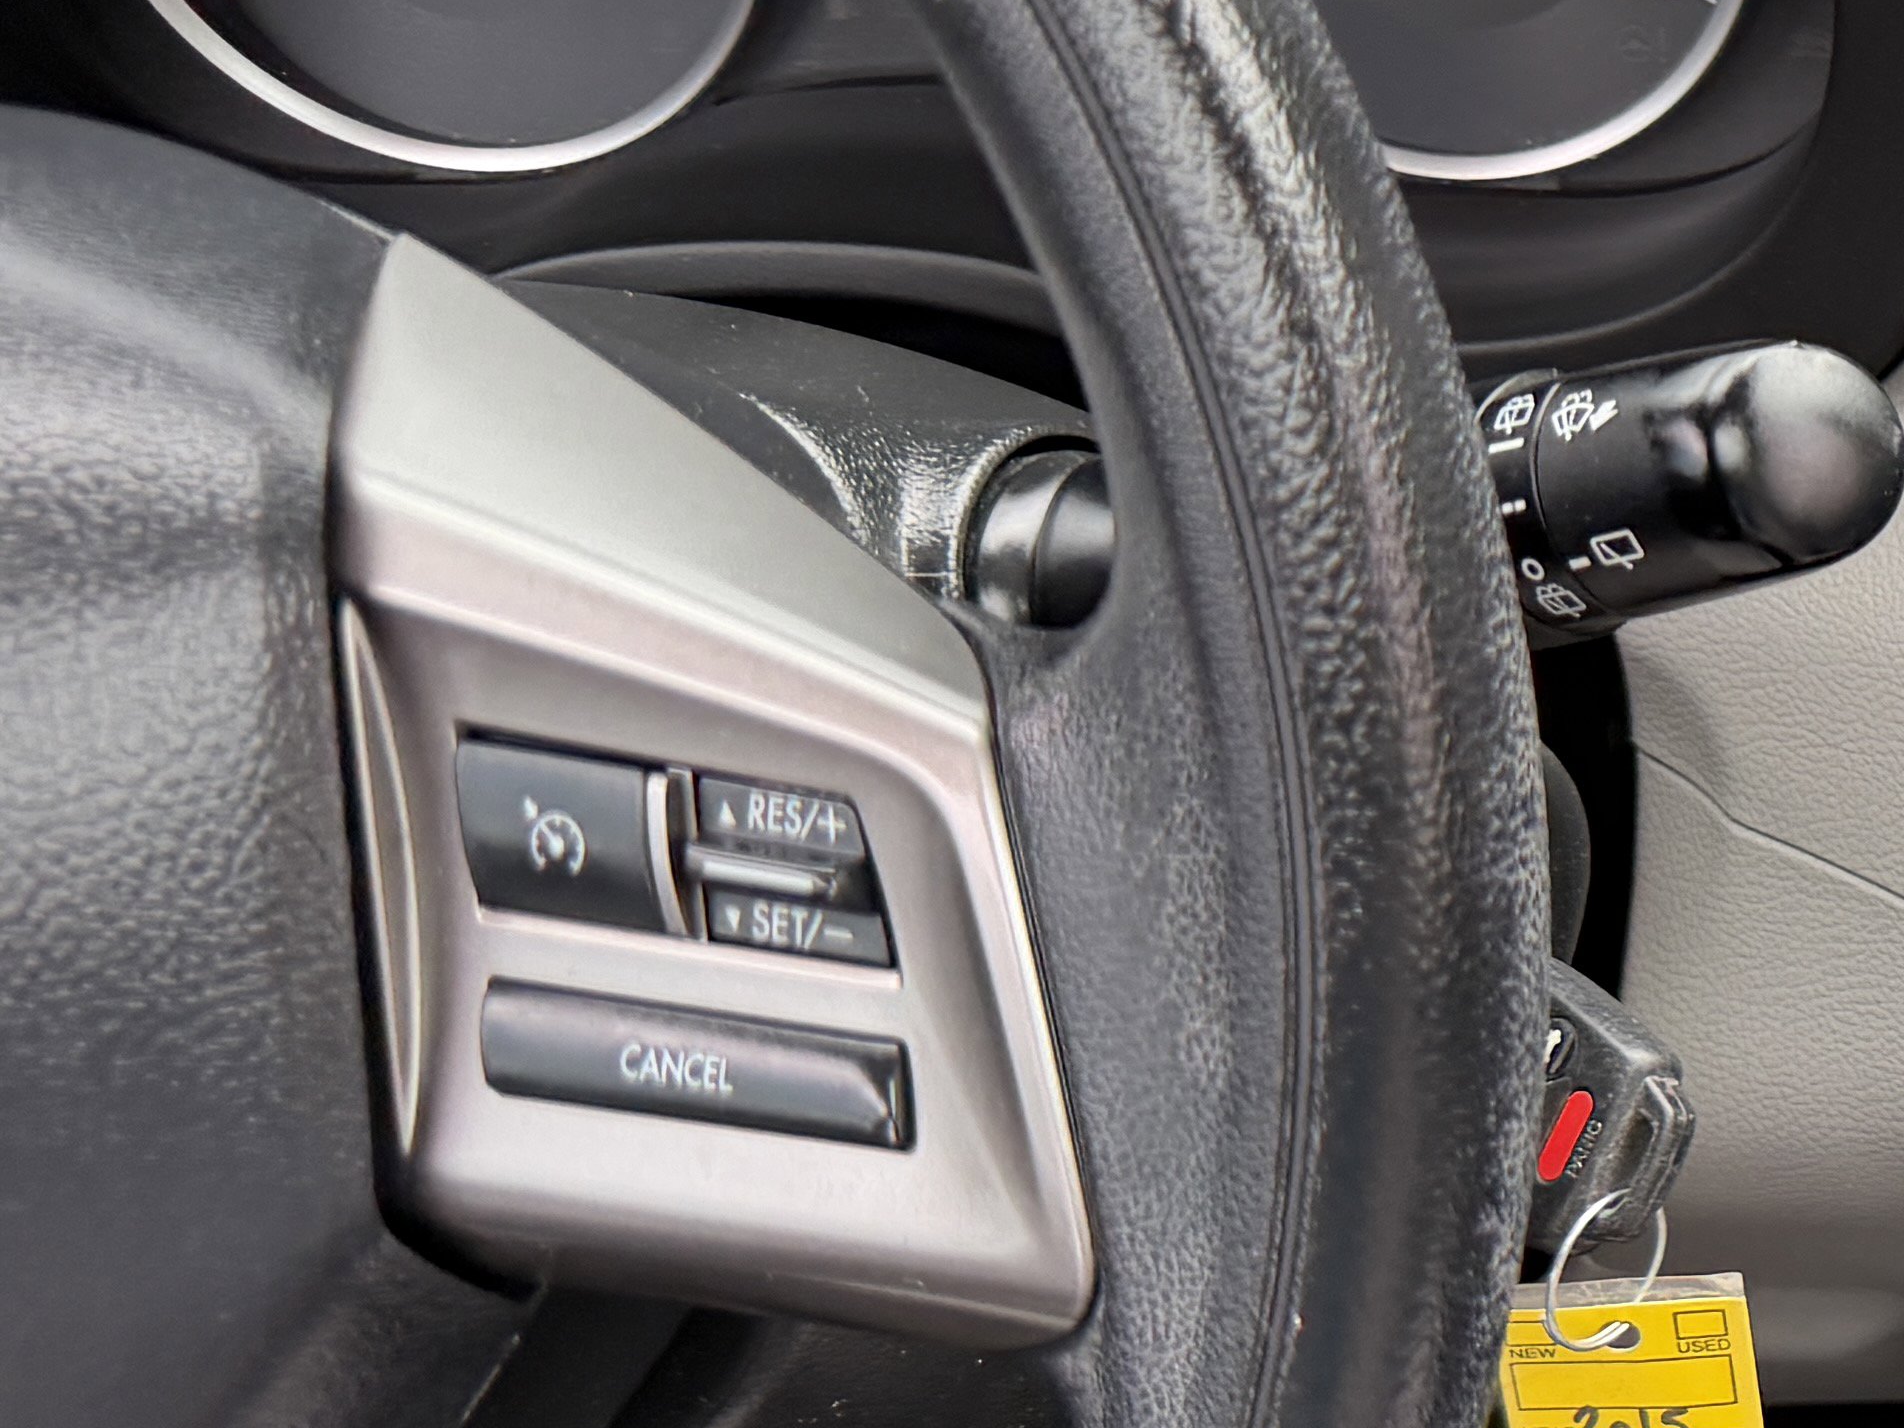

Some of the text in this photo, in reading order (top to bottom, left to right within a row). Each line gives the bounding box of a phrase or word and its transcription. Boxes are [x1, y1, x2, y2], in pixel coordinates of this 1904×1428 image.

[620, 1042, 733, 1095] CANCEL
[1510, 1348, 1556, 1359] NEW
[1677, 1339, 1731, 1354] USED
